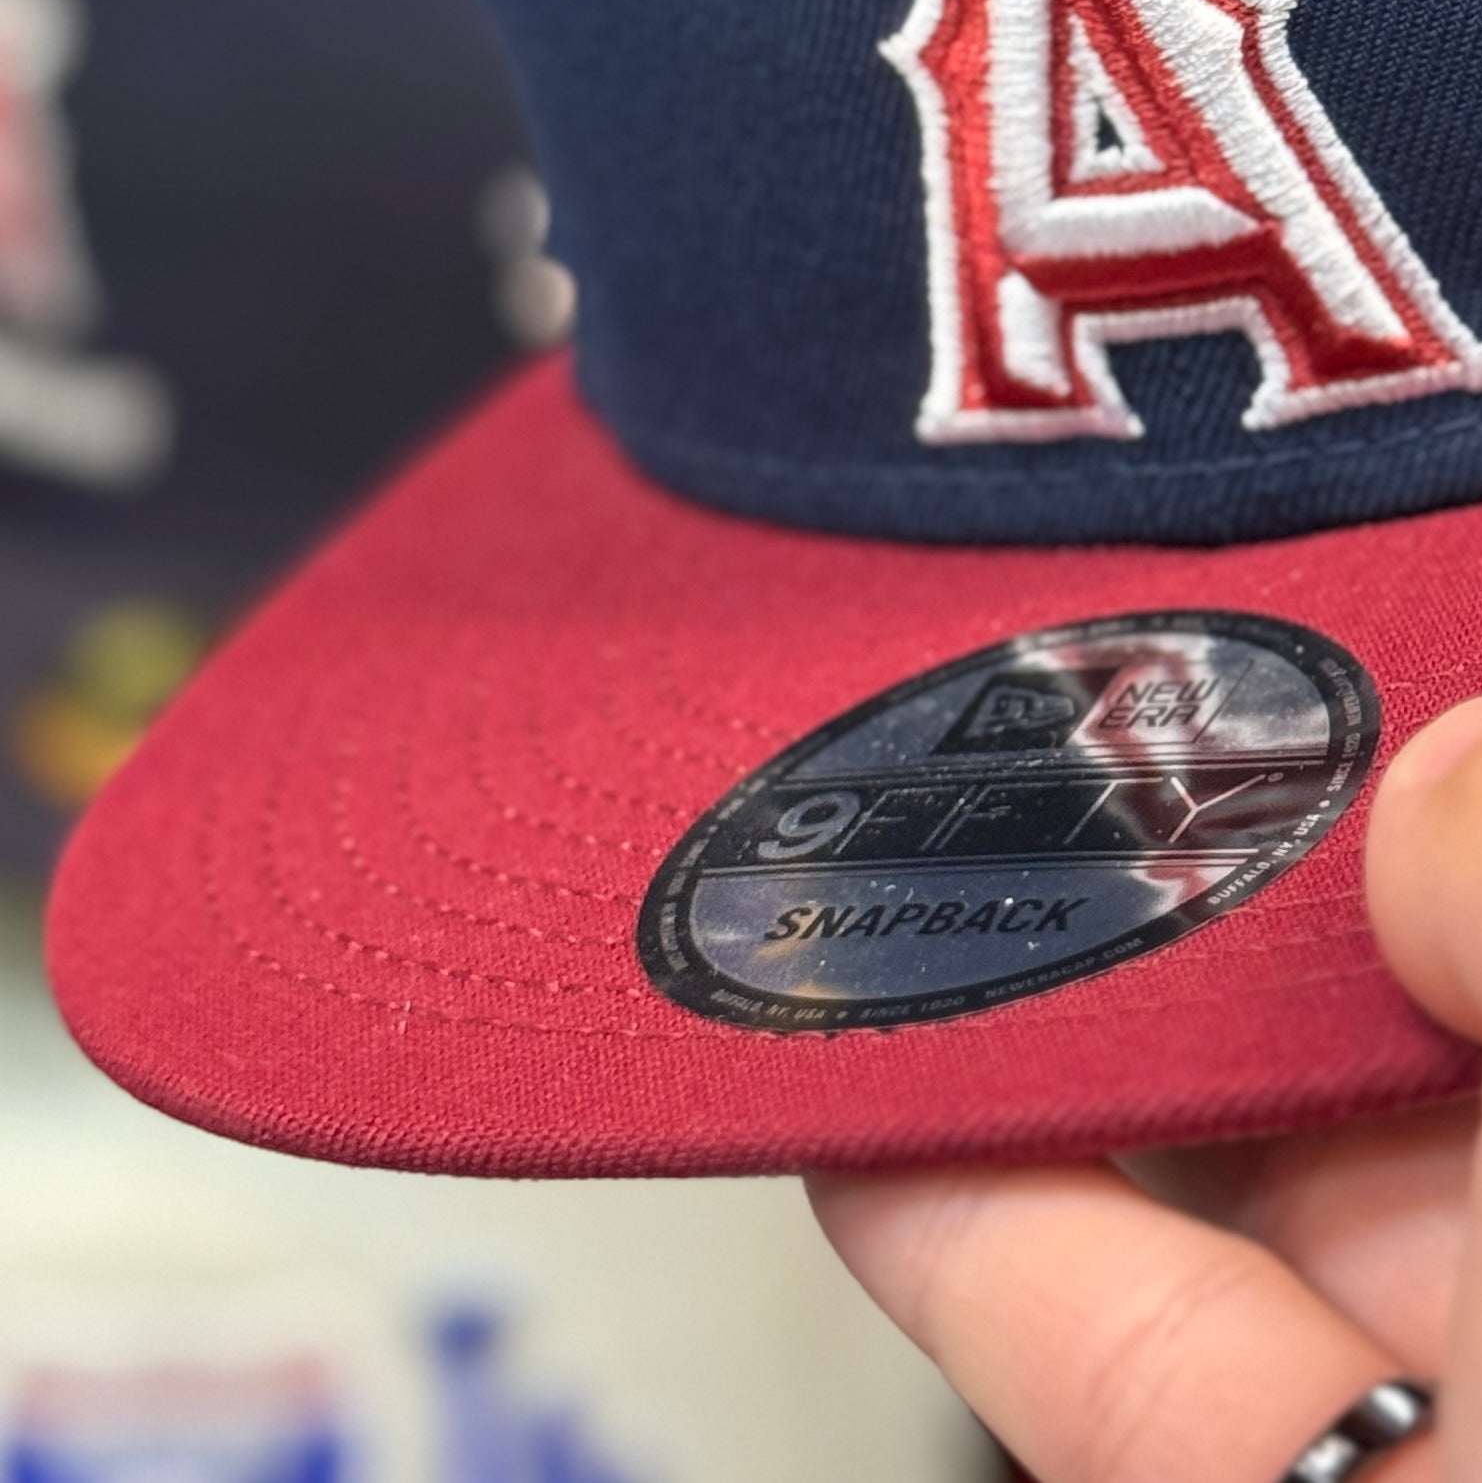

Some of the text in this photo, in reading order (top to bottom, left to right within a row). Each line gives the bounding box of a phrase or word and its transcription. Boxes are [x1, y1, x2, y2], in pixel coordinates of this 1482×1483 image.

[1116, 677, 1221, 705] NEW
[1098, 704, 1200, 730] ERA
[1293, 813, 1325, 837] USA
[764, 896, 1091, 940] SNAPBACK
